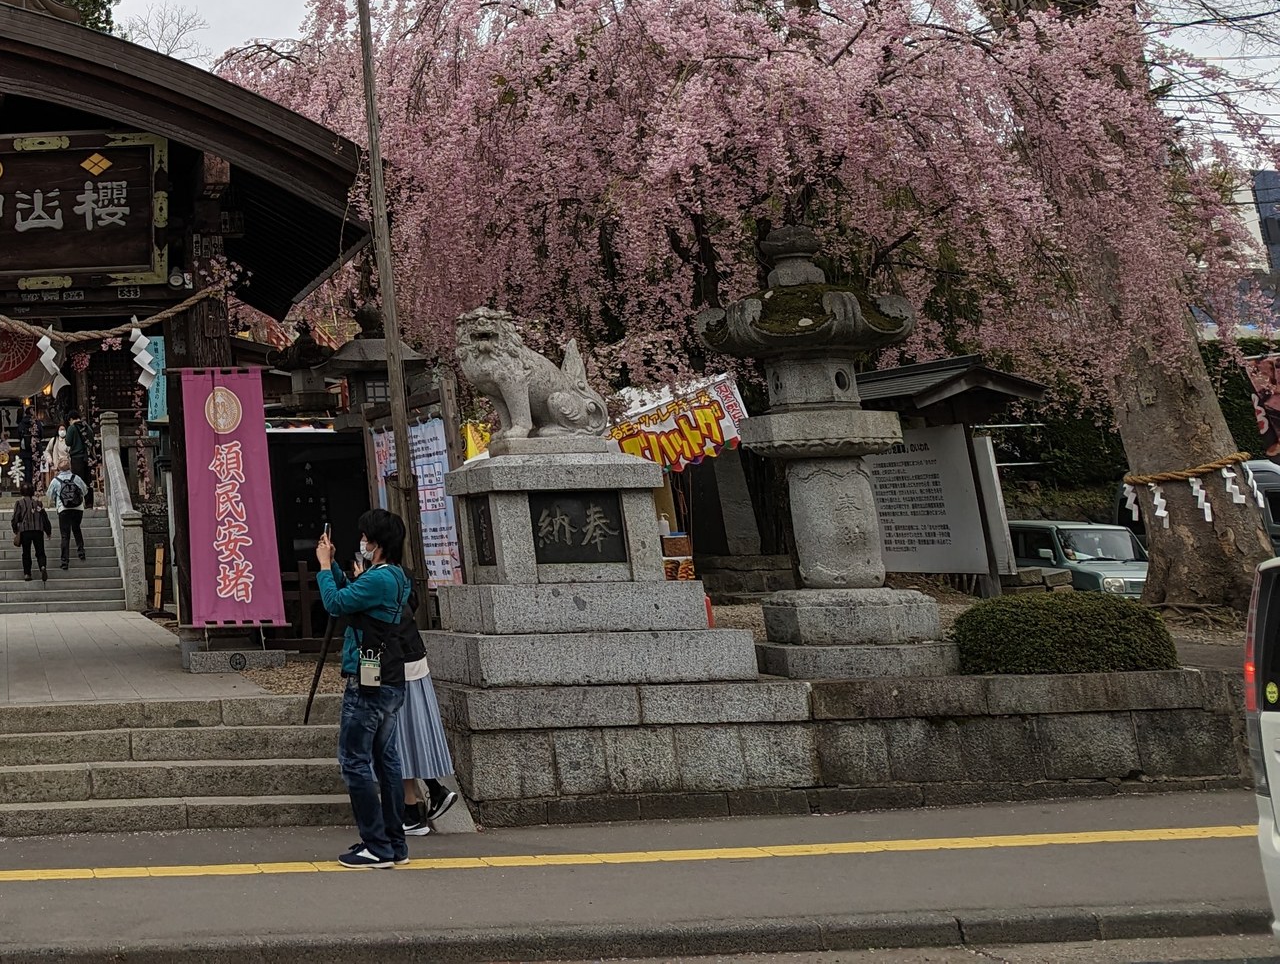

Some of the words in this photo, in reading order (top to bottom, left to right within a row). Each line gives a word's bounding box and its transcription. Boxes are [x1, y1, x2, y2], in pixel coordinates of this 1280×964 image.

[208, 440, 255, 604] 領民安堵
[538, 502, 619, 553] 奉納
